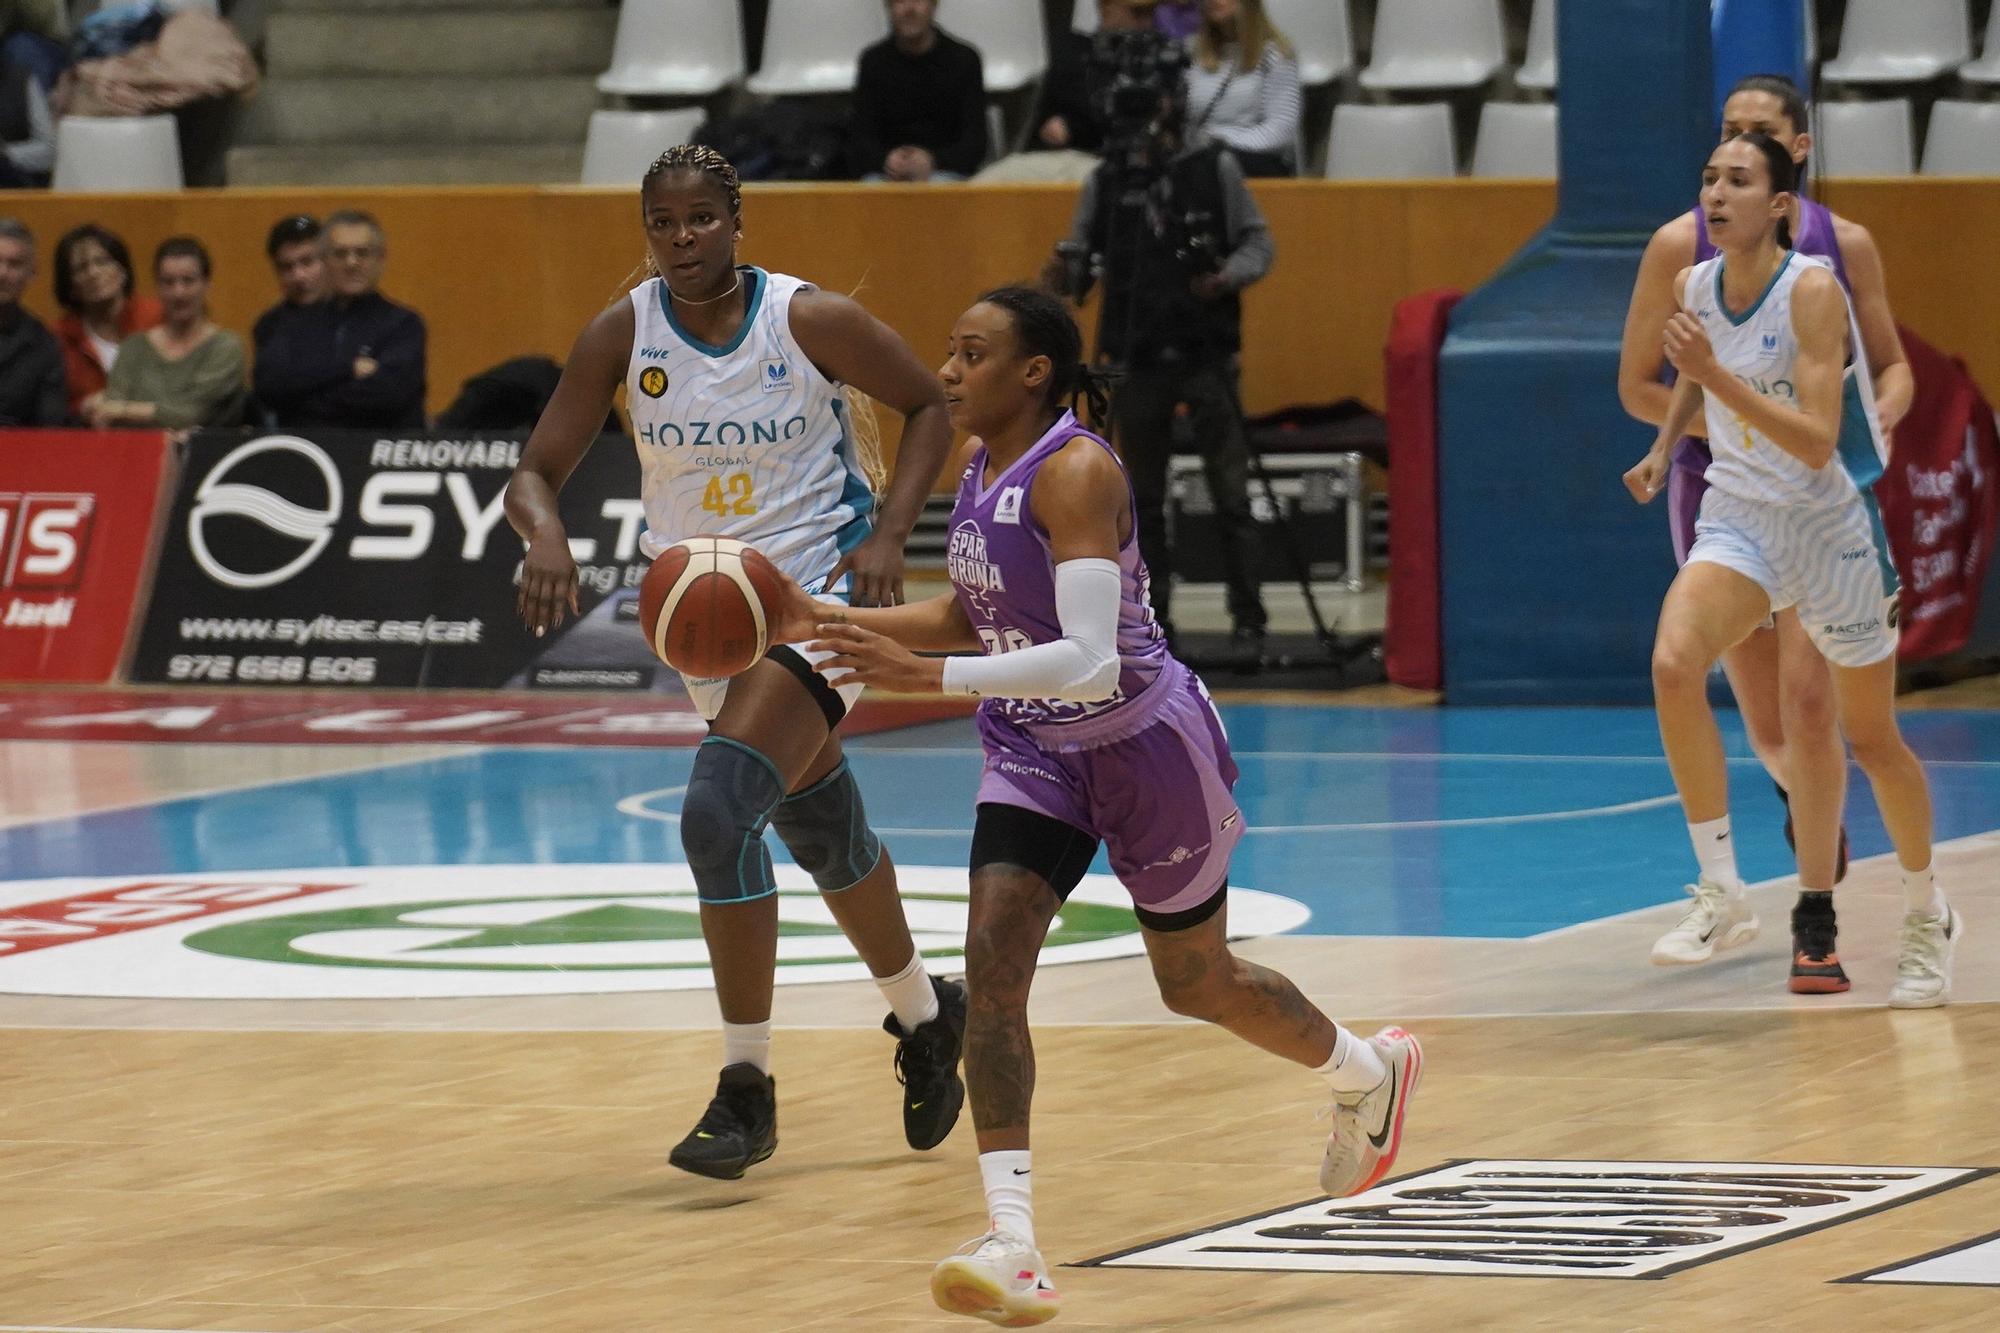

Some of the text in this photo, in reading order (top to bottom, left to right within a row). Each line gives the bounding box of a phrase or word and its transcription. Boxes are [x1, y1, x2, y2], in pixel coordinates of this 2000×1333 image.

[640, 416, 806, 446] HOZONO
[370, 440, 520, 468] RENOVABL
[696, 456, 752, 467] GLOBAL
[702, 473, 757, 517] 42
[950, 531, 986, 562] SPAR
[948, 556, 1005, 592] GIRONA
[180, 614, 485, 646] www.syltec.es/cat
[1836, 618, 1879, 634] ACTUA
[167, 655, 233, 680] 972
